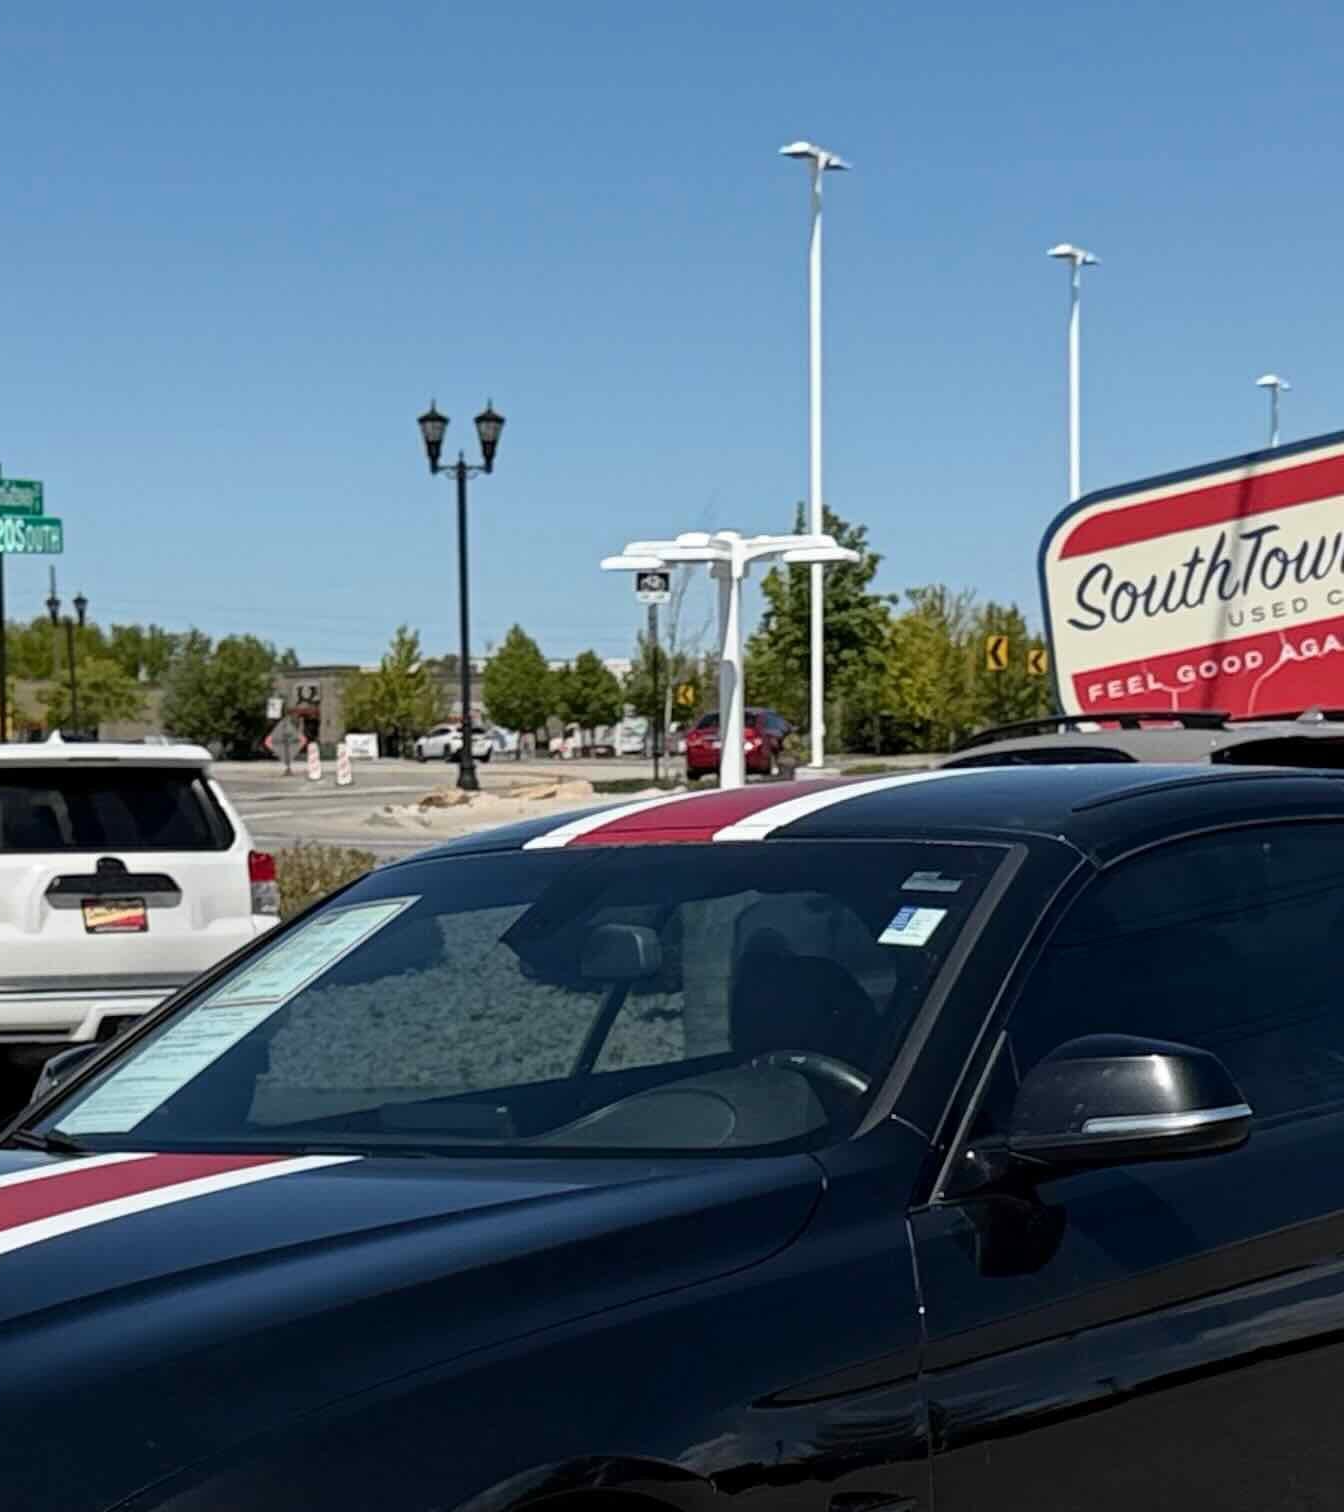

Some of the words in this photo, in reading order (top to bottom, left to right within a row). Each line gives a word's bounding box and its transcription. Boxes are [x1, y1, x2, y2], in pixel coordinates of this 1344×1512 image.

[1228, 597, 1308, 627] USED
[1087, 672, 1163, 703] FEEL
[1176, 651, 1264, 684] GOOD
